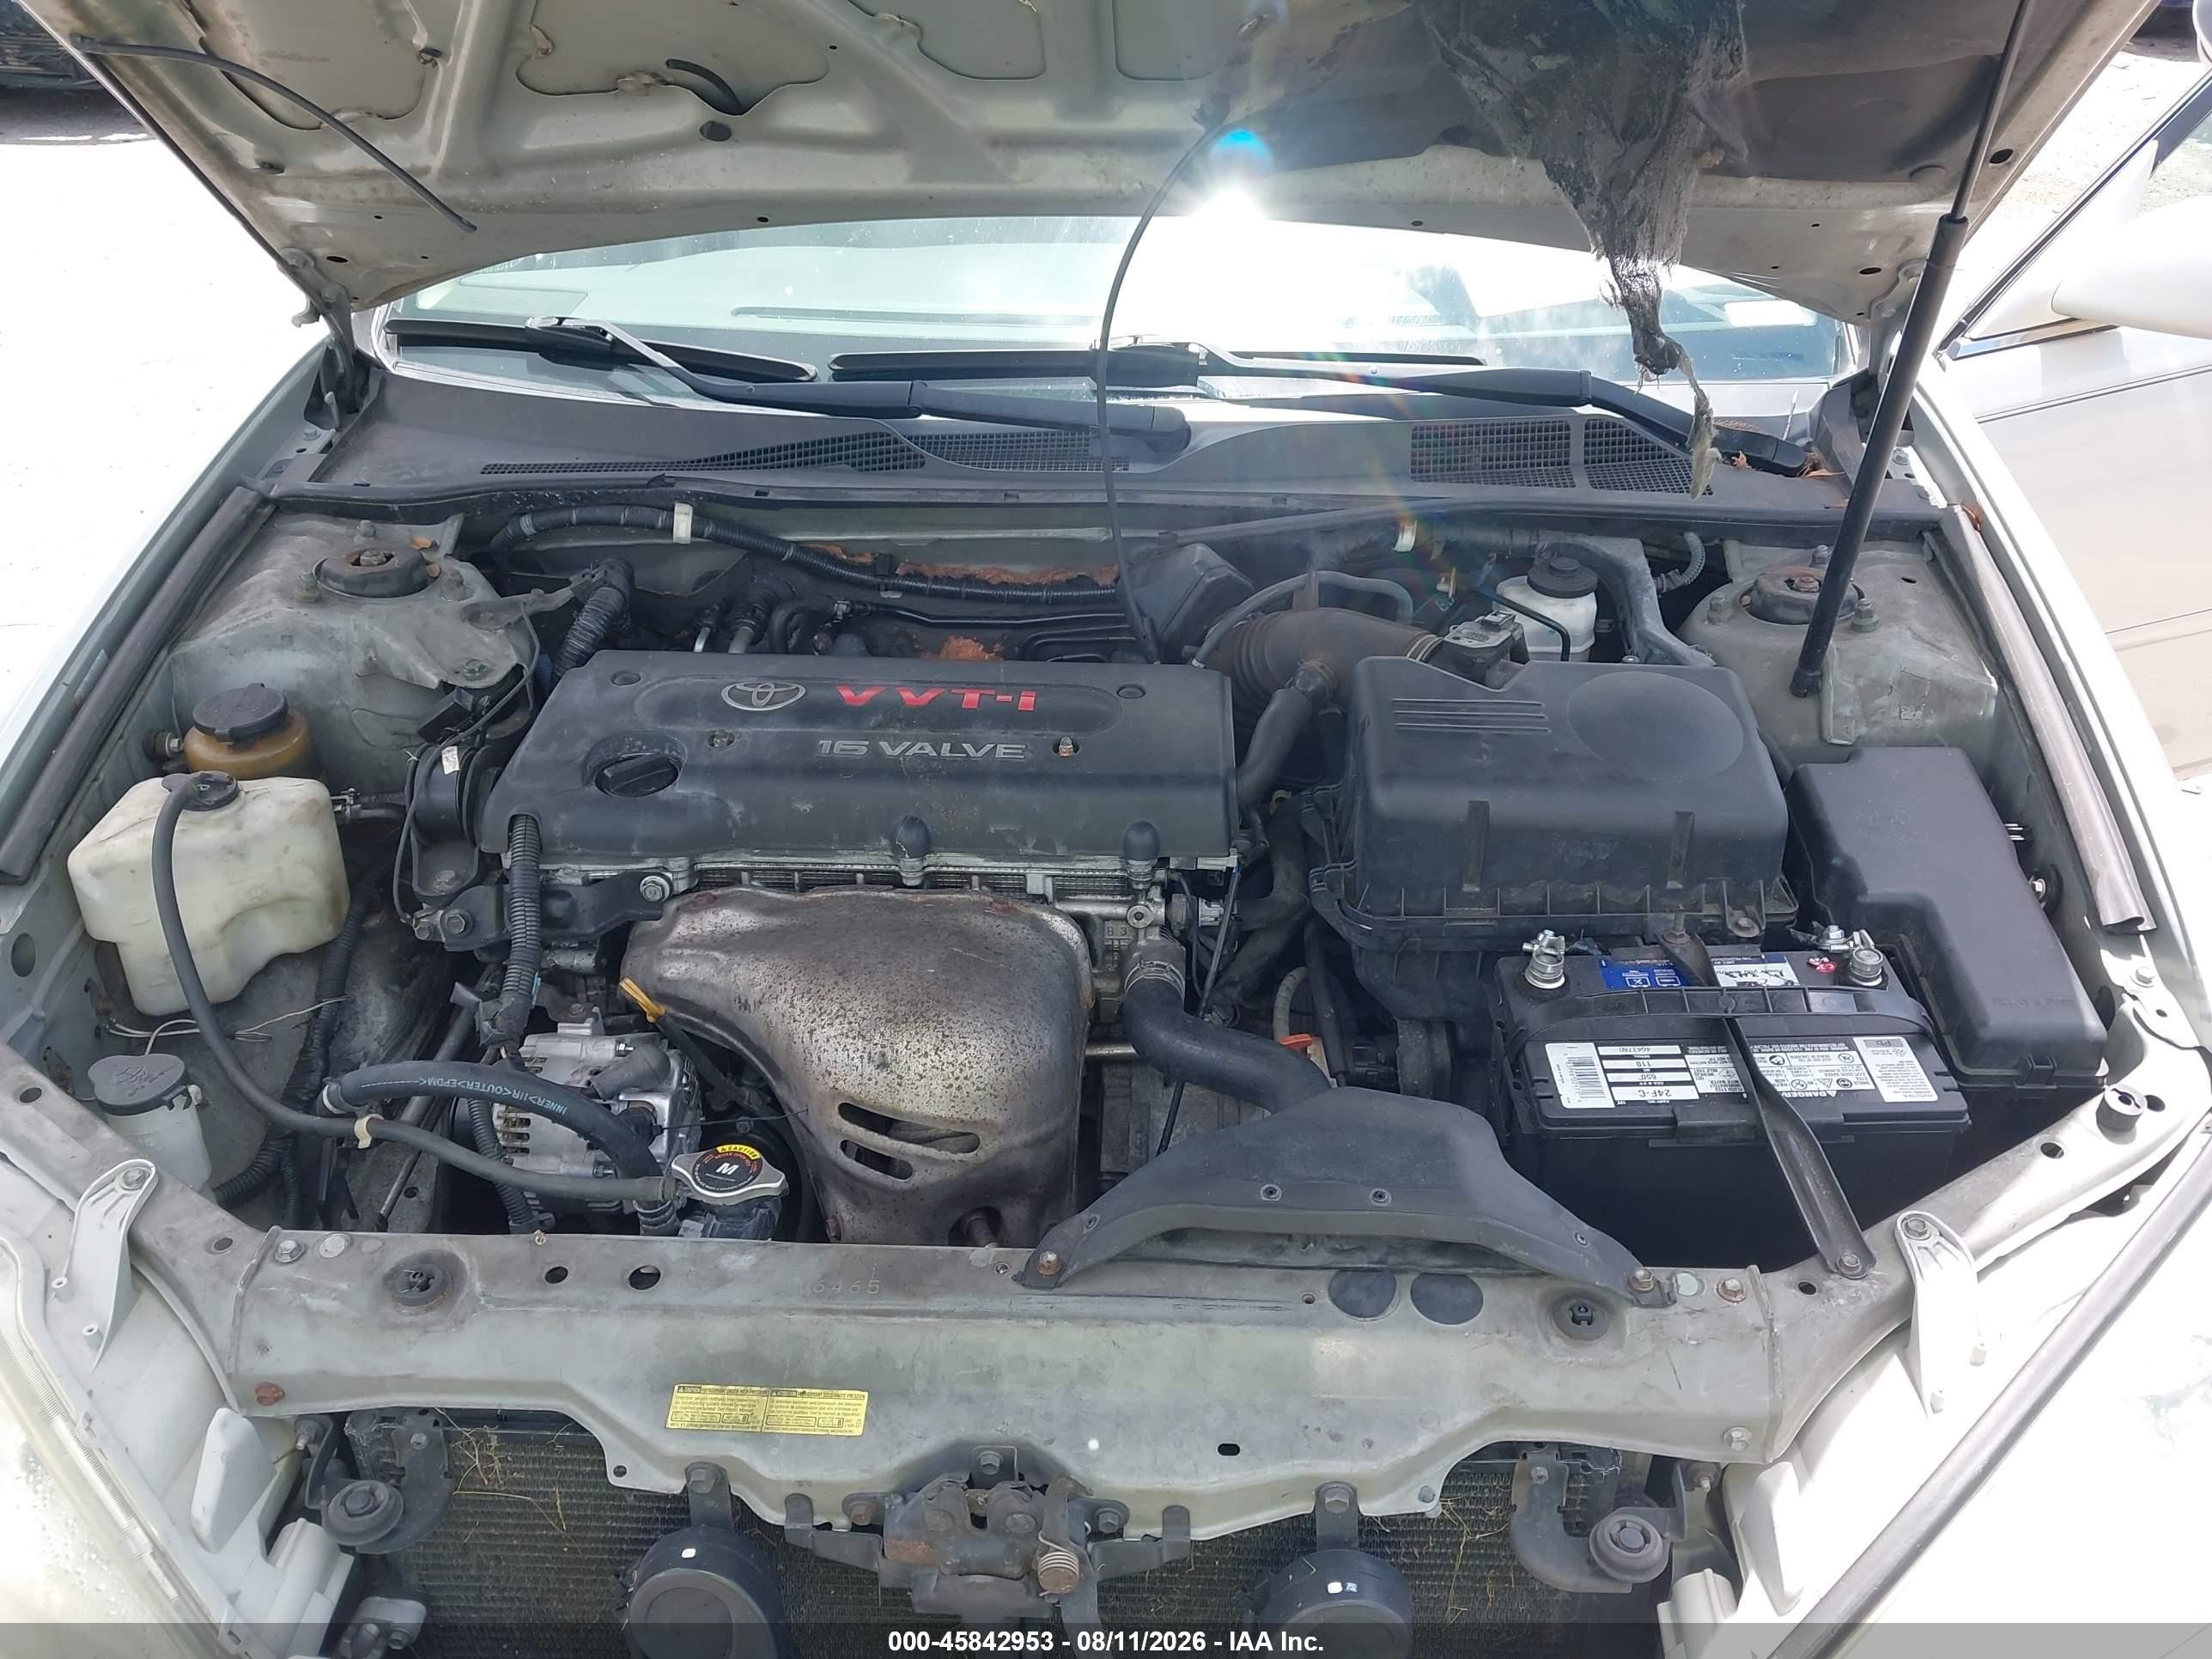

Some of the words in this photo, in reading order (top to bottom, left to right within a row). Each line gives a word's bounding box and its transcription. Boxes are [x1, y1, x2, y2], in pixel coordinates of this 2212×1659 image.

[817, 739, 871, 757] 16
[878, 740, 1028, 759] VALVE
[1638, 1089, 1672, 1098] 24F-C
[727, 1146, 757, 1158] CAUTION
[715, 1162, 740, 1176] M
